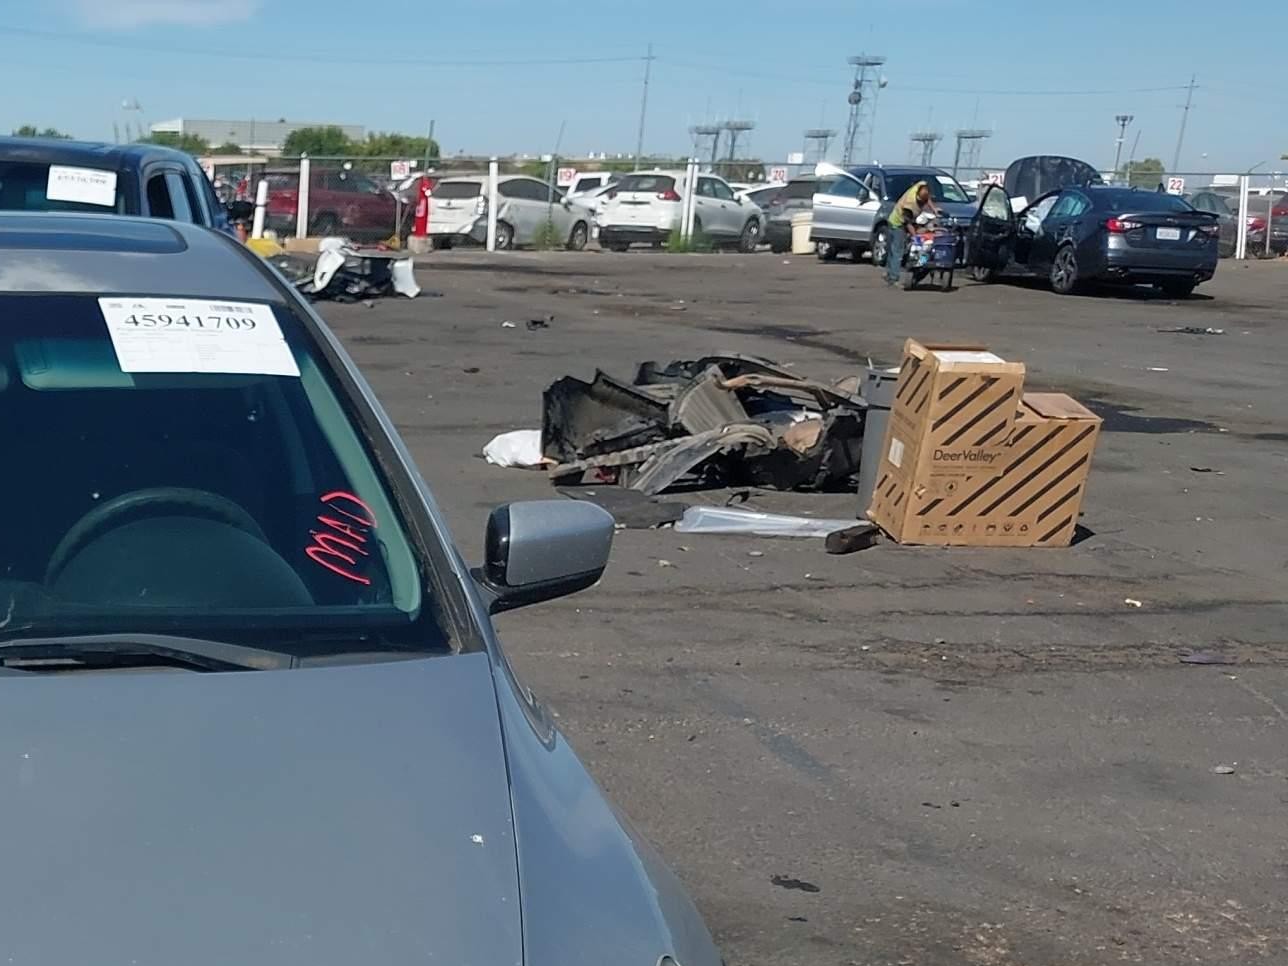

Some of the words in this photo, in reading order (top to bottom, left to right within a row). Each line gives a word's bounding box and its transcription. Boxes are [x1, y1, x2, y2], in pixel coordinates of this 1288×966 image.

[1169, 179, 1182, 190] 22
[124, 314, 257, 331] 45941709
[933, 449, 997, 464] DeerValley
